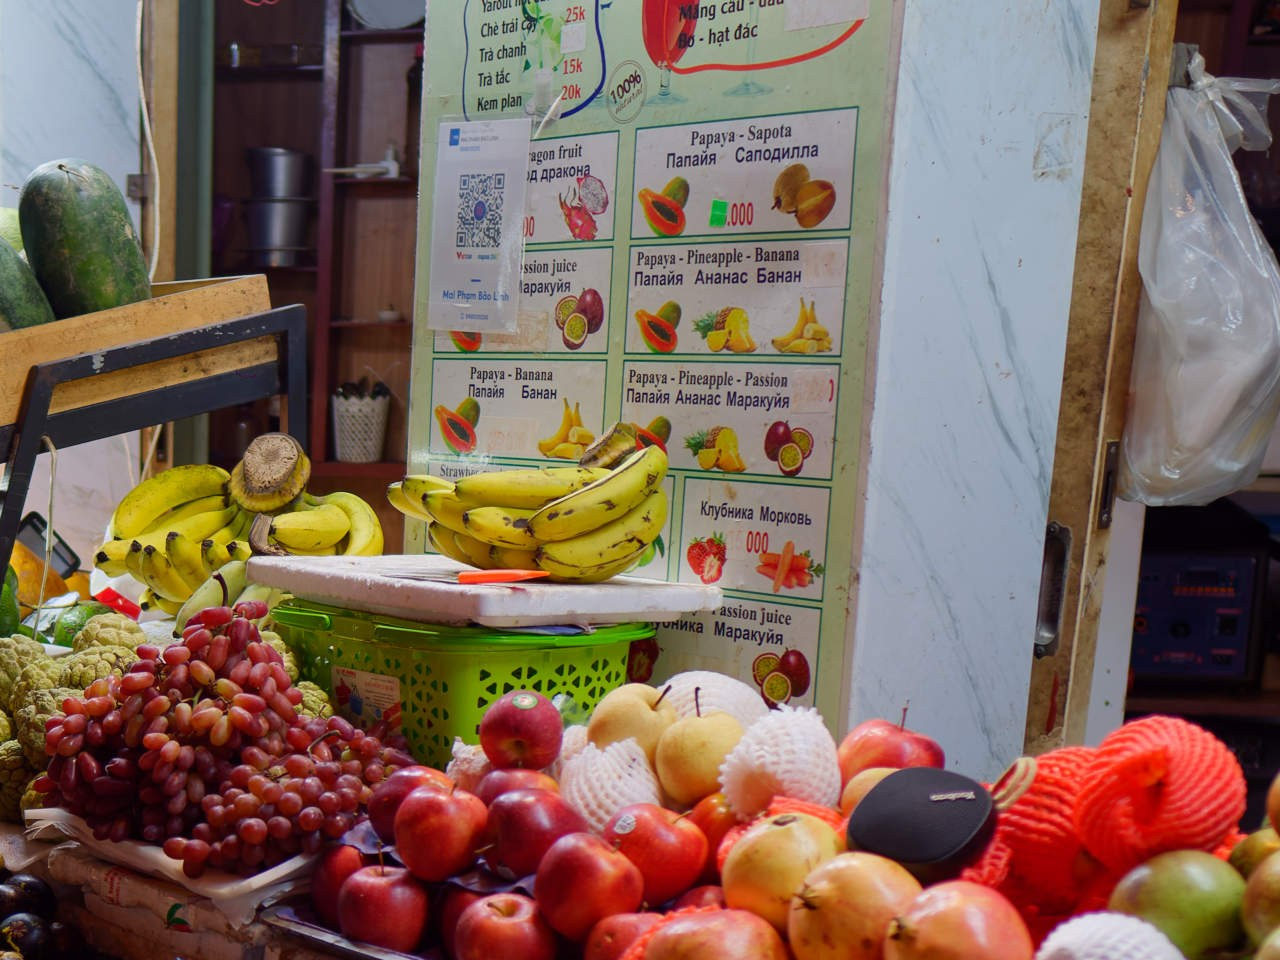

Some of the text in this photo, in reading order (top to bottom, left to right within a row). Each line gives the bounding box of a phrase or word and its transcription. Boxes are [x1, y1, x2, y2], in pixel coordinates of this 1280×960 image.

[565, 7, 586, 23] 25k
[480, 23, 499, 38] Chè
[502, 18, 519, 34] trái
[708, 26, 730, 47] hạt
[734, 22, 758, 40] đác
[479, 42, 527, 63] Trà chanh
[562, 60, 583, 75] 15k
[478, 72, 493, 88] Trà
[609, 70, 642, 105] 100%
[561, 84, 581, 101] 20k
[477, 98, 498, 112] Kem
[690, 128, 736, 149] Papaya
[748, 124, 793, 144] Sapota
[529, 143, 583, 166] agon fruit
[666, 144, 819, 169] Папайя Саподилла
[540, 164, 591, 183] дракона
[521, 258, 577, 276] ssion juice
[637, 251, 676, 269] Papaya
[687, 248, 743, 267] Pineapple
[755, 247, 800, 263] Banana
[634, 267, 802, 286] Папайя Ананас Банан
[493, 289, 510, 302] Lnh
[469, 366, 505, 384] Papaya
[515, 367, 553, 382] Banana
[628, 369, 668, 388] Papaya
[678, 370, 734, 390] Pineapple
[745, 372, 788, 388] Passion
[468, 383, 557, 400] Папайя Банан
[626, 388, 790, 412] Папайя Ананас Маракуйя
[700, 500, 812, 526] Клубника Морковь
[714, 604, 792, 626] assion juice
[714, 620, 784, 646] Маракуйя
